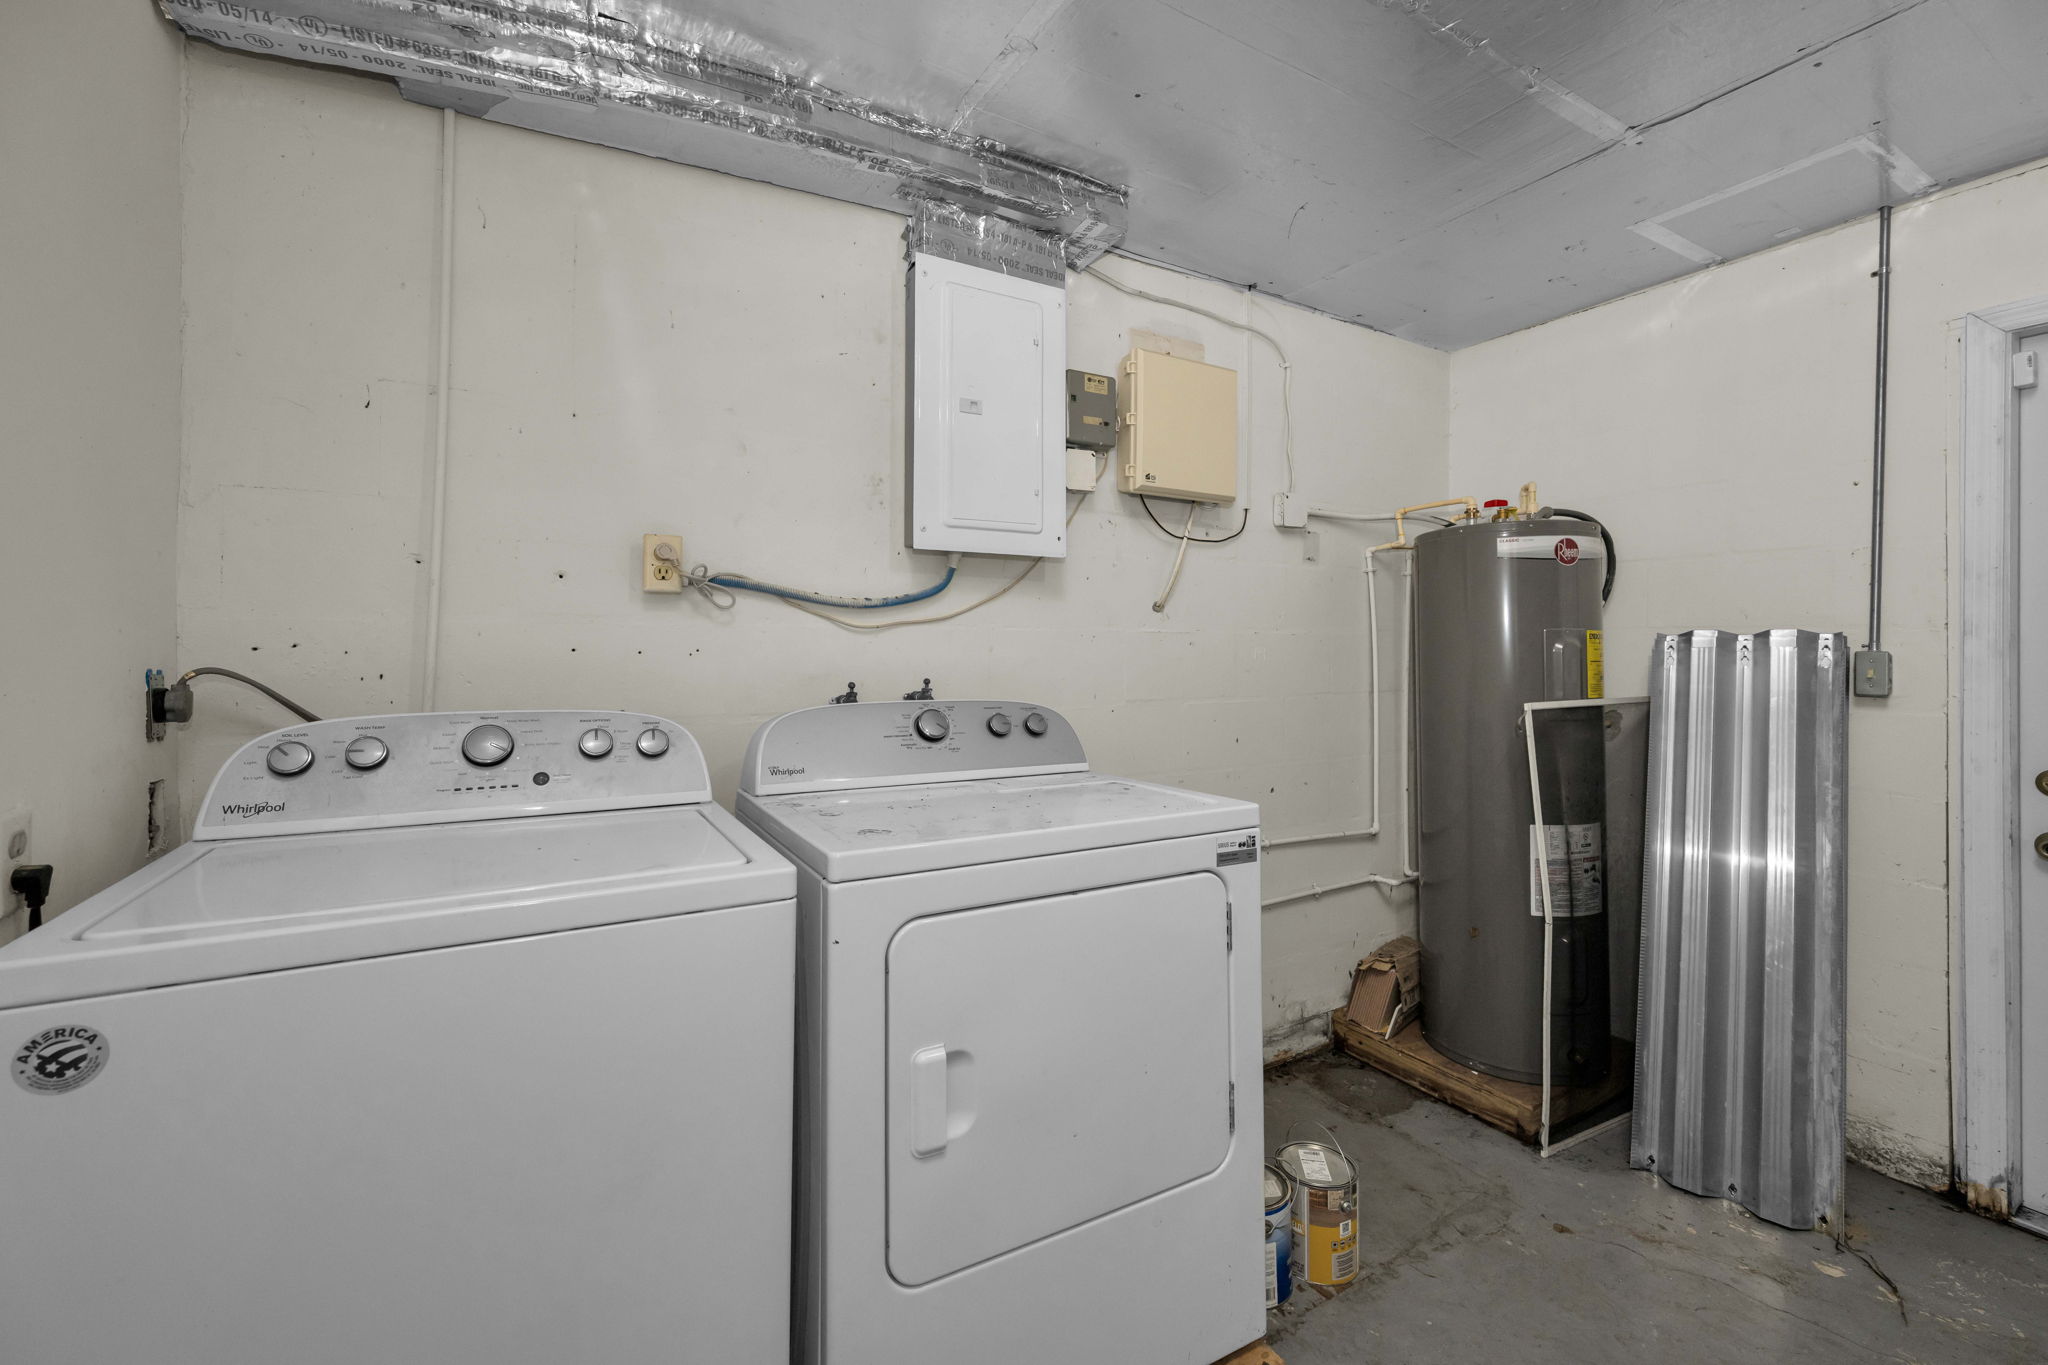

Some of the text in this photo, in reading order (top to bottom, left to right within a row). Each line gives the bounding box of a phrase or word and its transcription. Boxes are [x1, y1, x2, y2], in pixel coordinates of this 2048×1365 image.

[217, 0, 273, 26] 05/14
[340, 24, 394, 49] LISTED
[298, 42, 348, 60] 05/14
[362, 54, 407, 71] 2000
[455, 72, 498, 88] IDEAL
[999, 255, 1021, 270] 2000
[1556, 538, 1580, 561] Rheem
[769, 767, 806, 777] Whirlpool
[222, 801, 286, 818] Whirlpool
[16, 1026, 99, 1065] AMERICA
